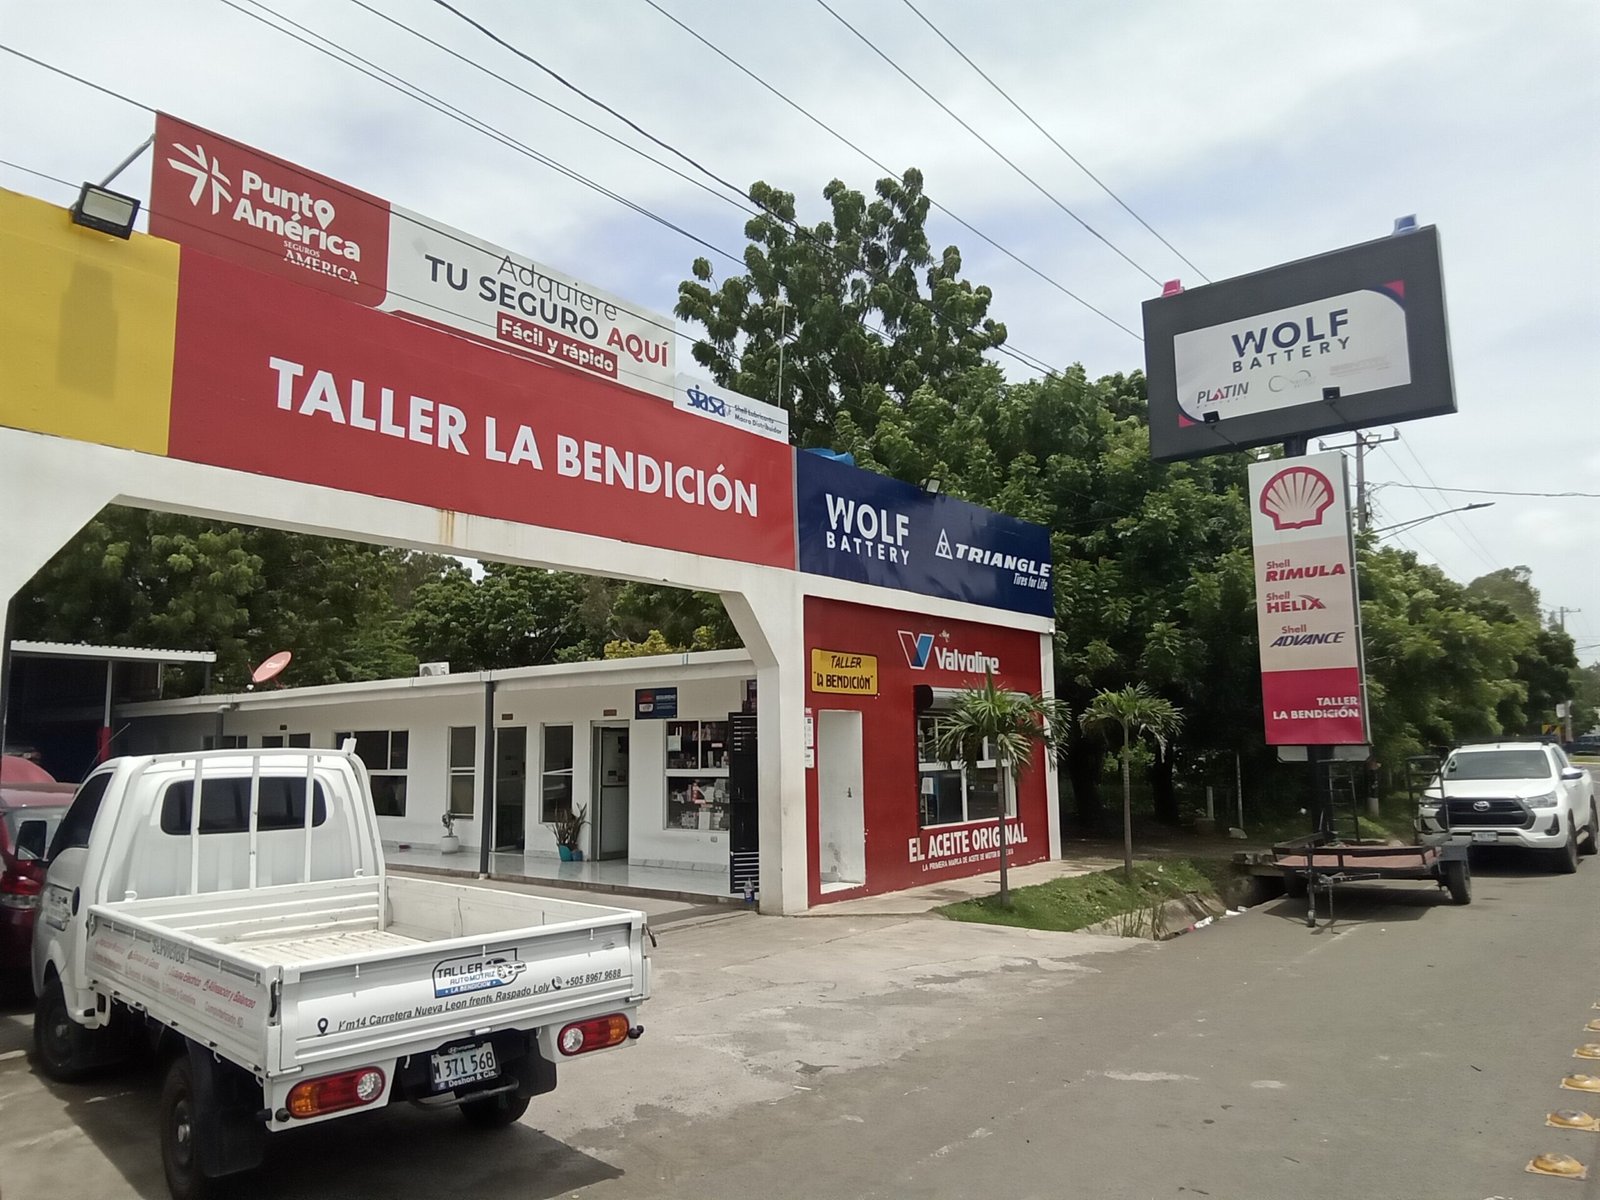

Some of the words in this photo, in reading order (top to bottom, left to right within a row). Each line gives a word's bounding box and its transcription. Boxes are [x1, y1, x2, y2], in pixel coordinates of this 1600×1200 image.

[242, 169, 335, 230] Punto
[233, 198, 361, 262] América
[284, 240, 321, 257] SEGUROS
[497, 255, 618, 322] Adquiere
[425, 254, 469, 291] TU
[479, 275, 599, 341] SEGURO
[607, 327, 670, 368] AQUÍ
[1231, 308, 1349, 358] WOLF
[501, 317, 543, 347] Fácil
[547, 337, 559, 355] y
[562, 341, 615, 374] rápido
[1232, 336, 1351, 374] BATTERY
[1196, 381, 1250, 404] PLATIN
[735, 414, 751, 425] Macro
[269, 356, 469, 456] TALLER
[485, 415, 543, 471] LA
[557, 434, 758, 517] BENDICIÓN
[825, 493, 910, 546] WOLF
[826, 531, 911, 566] BATTERY
[955, 543, 1052, 578] TRIANGLE
[1266, 559, 1291, 570] Shell
[1013, 573, 1027, 586] Tires
[1028, 575, 1037, 588] for
[1038, 576, 1049, 591] Life
[1265, 563, 1347, 583] RIMULA
[1266, 591, 1291, 602] Shell
[1266, 594, 1327, 614] HELIX
[1269, 631, 1346, 648] ADVANCE
[1281, 624, 1307, 635] Shell
[831, 655, 862, 669] TALLER
[934, 646, 1001, 675] Valvoline
[1273, 710, 1288, 720] LA
[1290, 704, 1360, 719] BENDICIÓN
[1316, 696, 1359, 707] TALLER
[909, 837, 925, 862] EL
[927, 830, 970, 859] ACEITE
[972, 822, 1027, 850] ORIGNAL
[922, 863, 929, 871] LA
[929, 860, 948, 870] PRIMERA
[948, 858, 962, 867] MARCA
[437, 962, 483, 979] TALLER
[369, 1008, 413, 1026] Carretera
[414, 1001, 443, 1016] Nueva
[444, 998, 468, 1012] Leon
[496, 984, 532, 1003] Raspado
[533, 981, 551, 996] Loly
[565, 975, 584, 987] +505
[604, 968, 622, 980] 9688
[444, 1056, 467, 1078] 371
[470, 1051, 494, 1073] 568
[448, 1075, 476, 1088] Deshon
[476, 1073, 483, 1081] &
